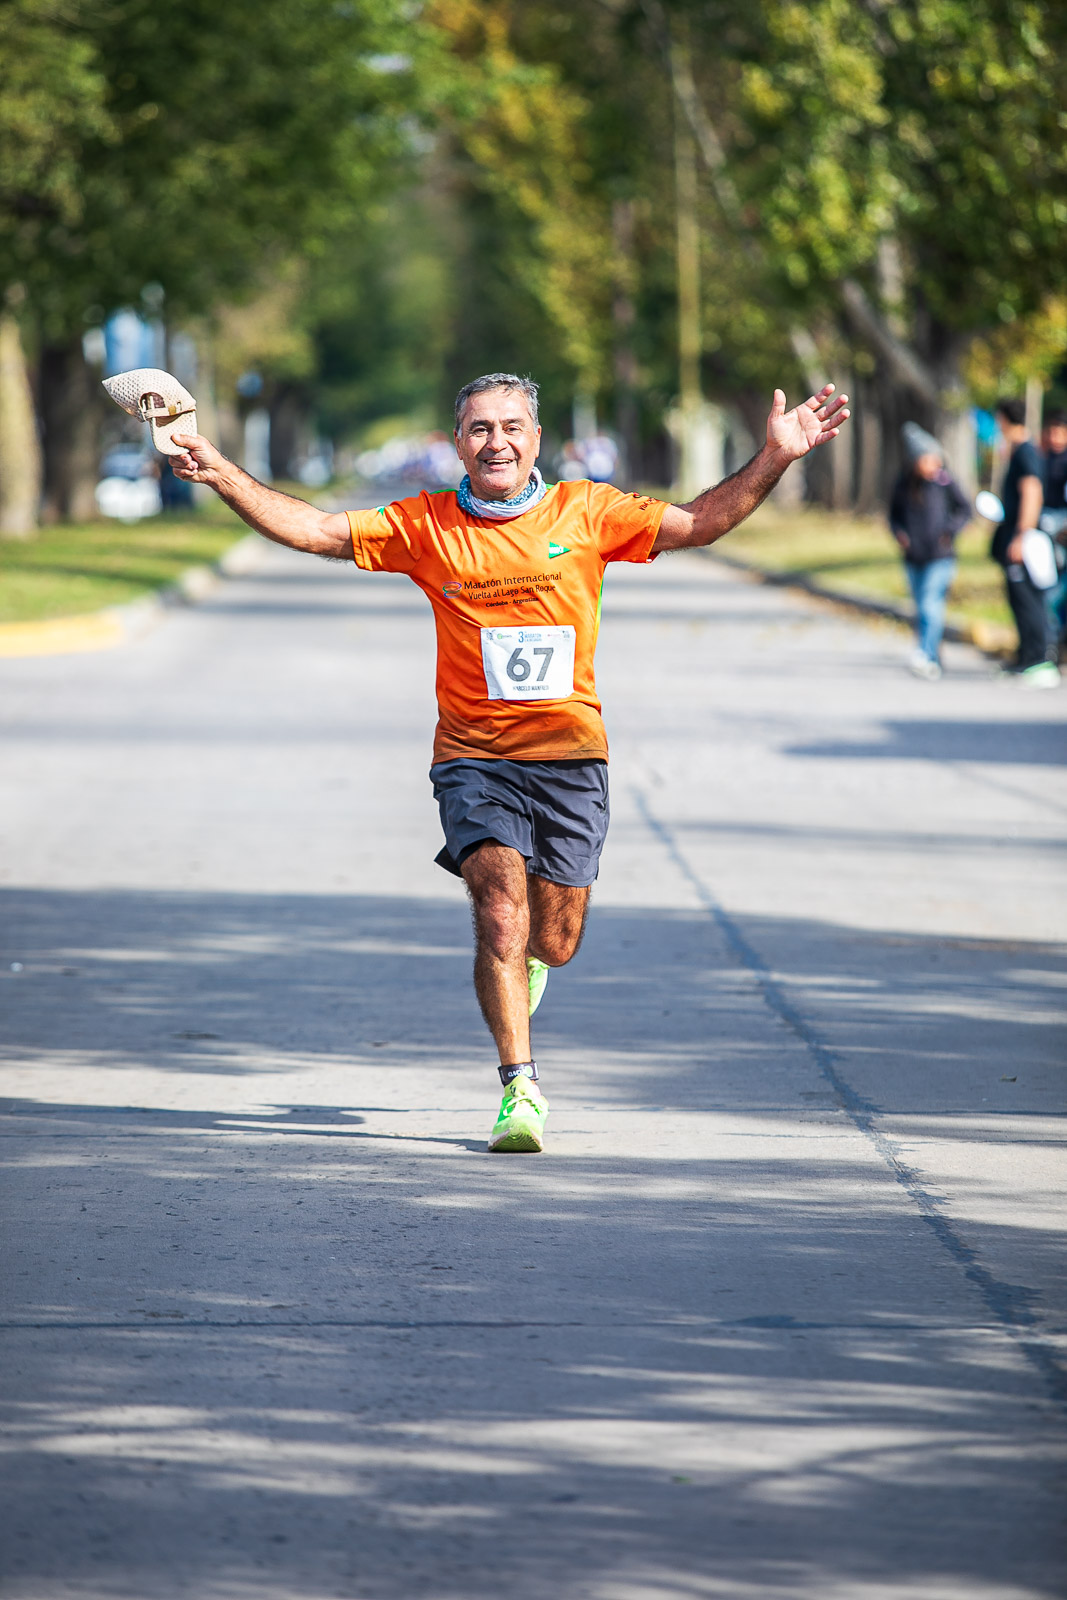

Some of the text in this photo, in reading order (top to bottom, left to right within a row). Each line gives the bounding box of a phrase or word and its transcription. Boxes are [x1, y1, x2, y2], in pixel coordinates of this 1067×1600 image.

[464, 571, 562, 590] Maratón Internacional
[468, 584, 556, 600] Vuelta al Lago San Roque
[512, 597, 539, 605] Argentina
[518, 631, 524, 643] 3
[506, 647, 554, 682] 67
